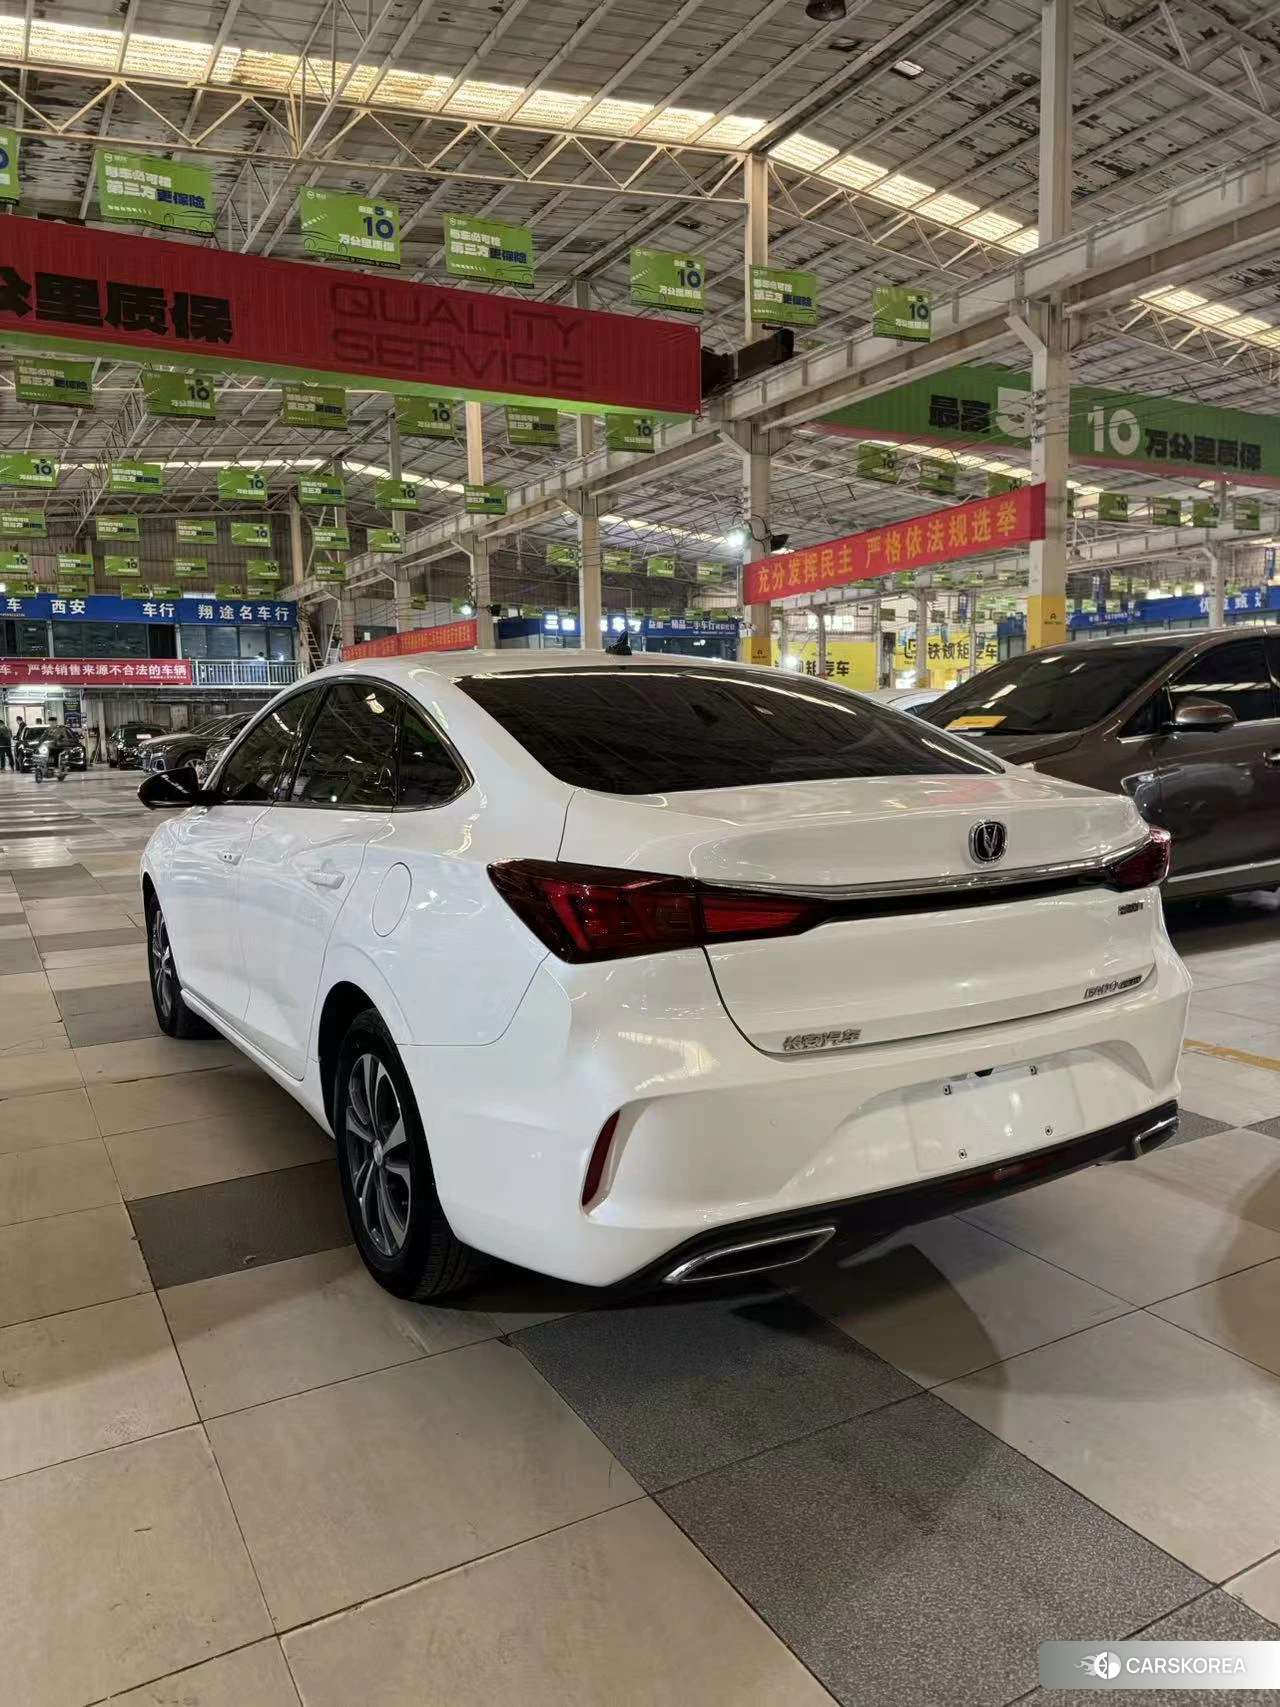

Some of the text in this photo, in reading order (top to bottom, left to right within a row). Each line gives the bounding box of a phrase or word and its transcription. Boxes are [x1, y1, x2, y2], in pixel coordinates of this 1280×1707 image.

[363, 216, 394, 239] 10
[678, 269, 701, 288] 10
[330, 282, 582, 347] QUALITY
[909, 303, 928, 320] 10
[333, 328, 586, 392] SERVICE
[188, 384, 211, 400] 10
[431, 408, 451, 422] 10
[636, 425, 652, 436] 10
[1087, 405, 1141, 455] 10
[34, 463, 52, 475] 10
[250, 478, 264, 490] 10
[401, 489, 416, 499] 10
[758, 500, 1017, 593] 充分发挥民主 严格依法规选举
[6, 598, 22, 612] 车
[51, 599, 176, 618] 西安 车行
[198, 604, 289, 621] 翔途名车行
